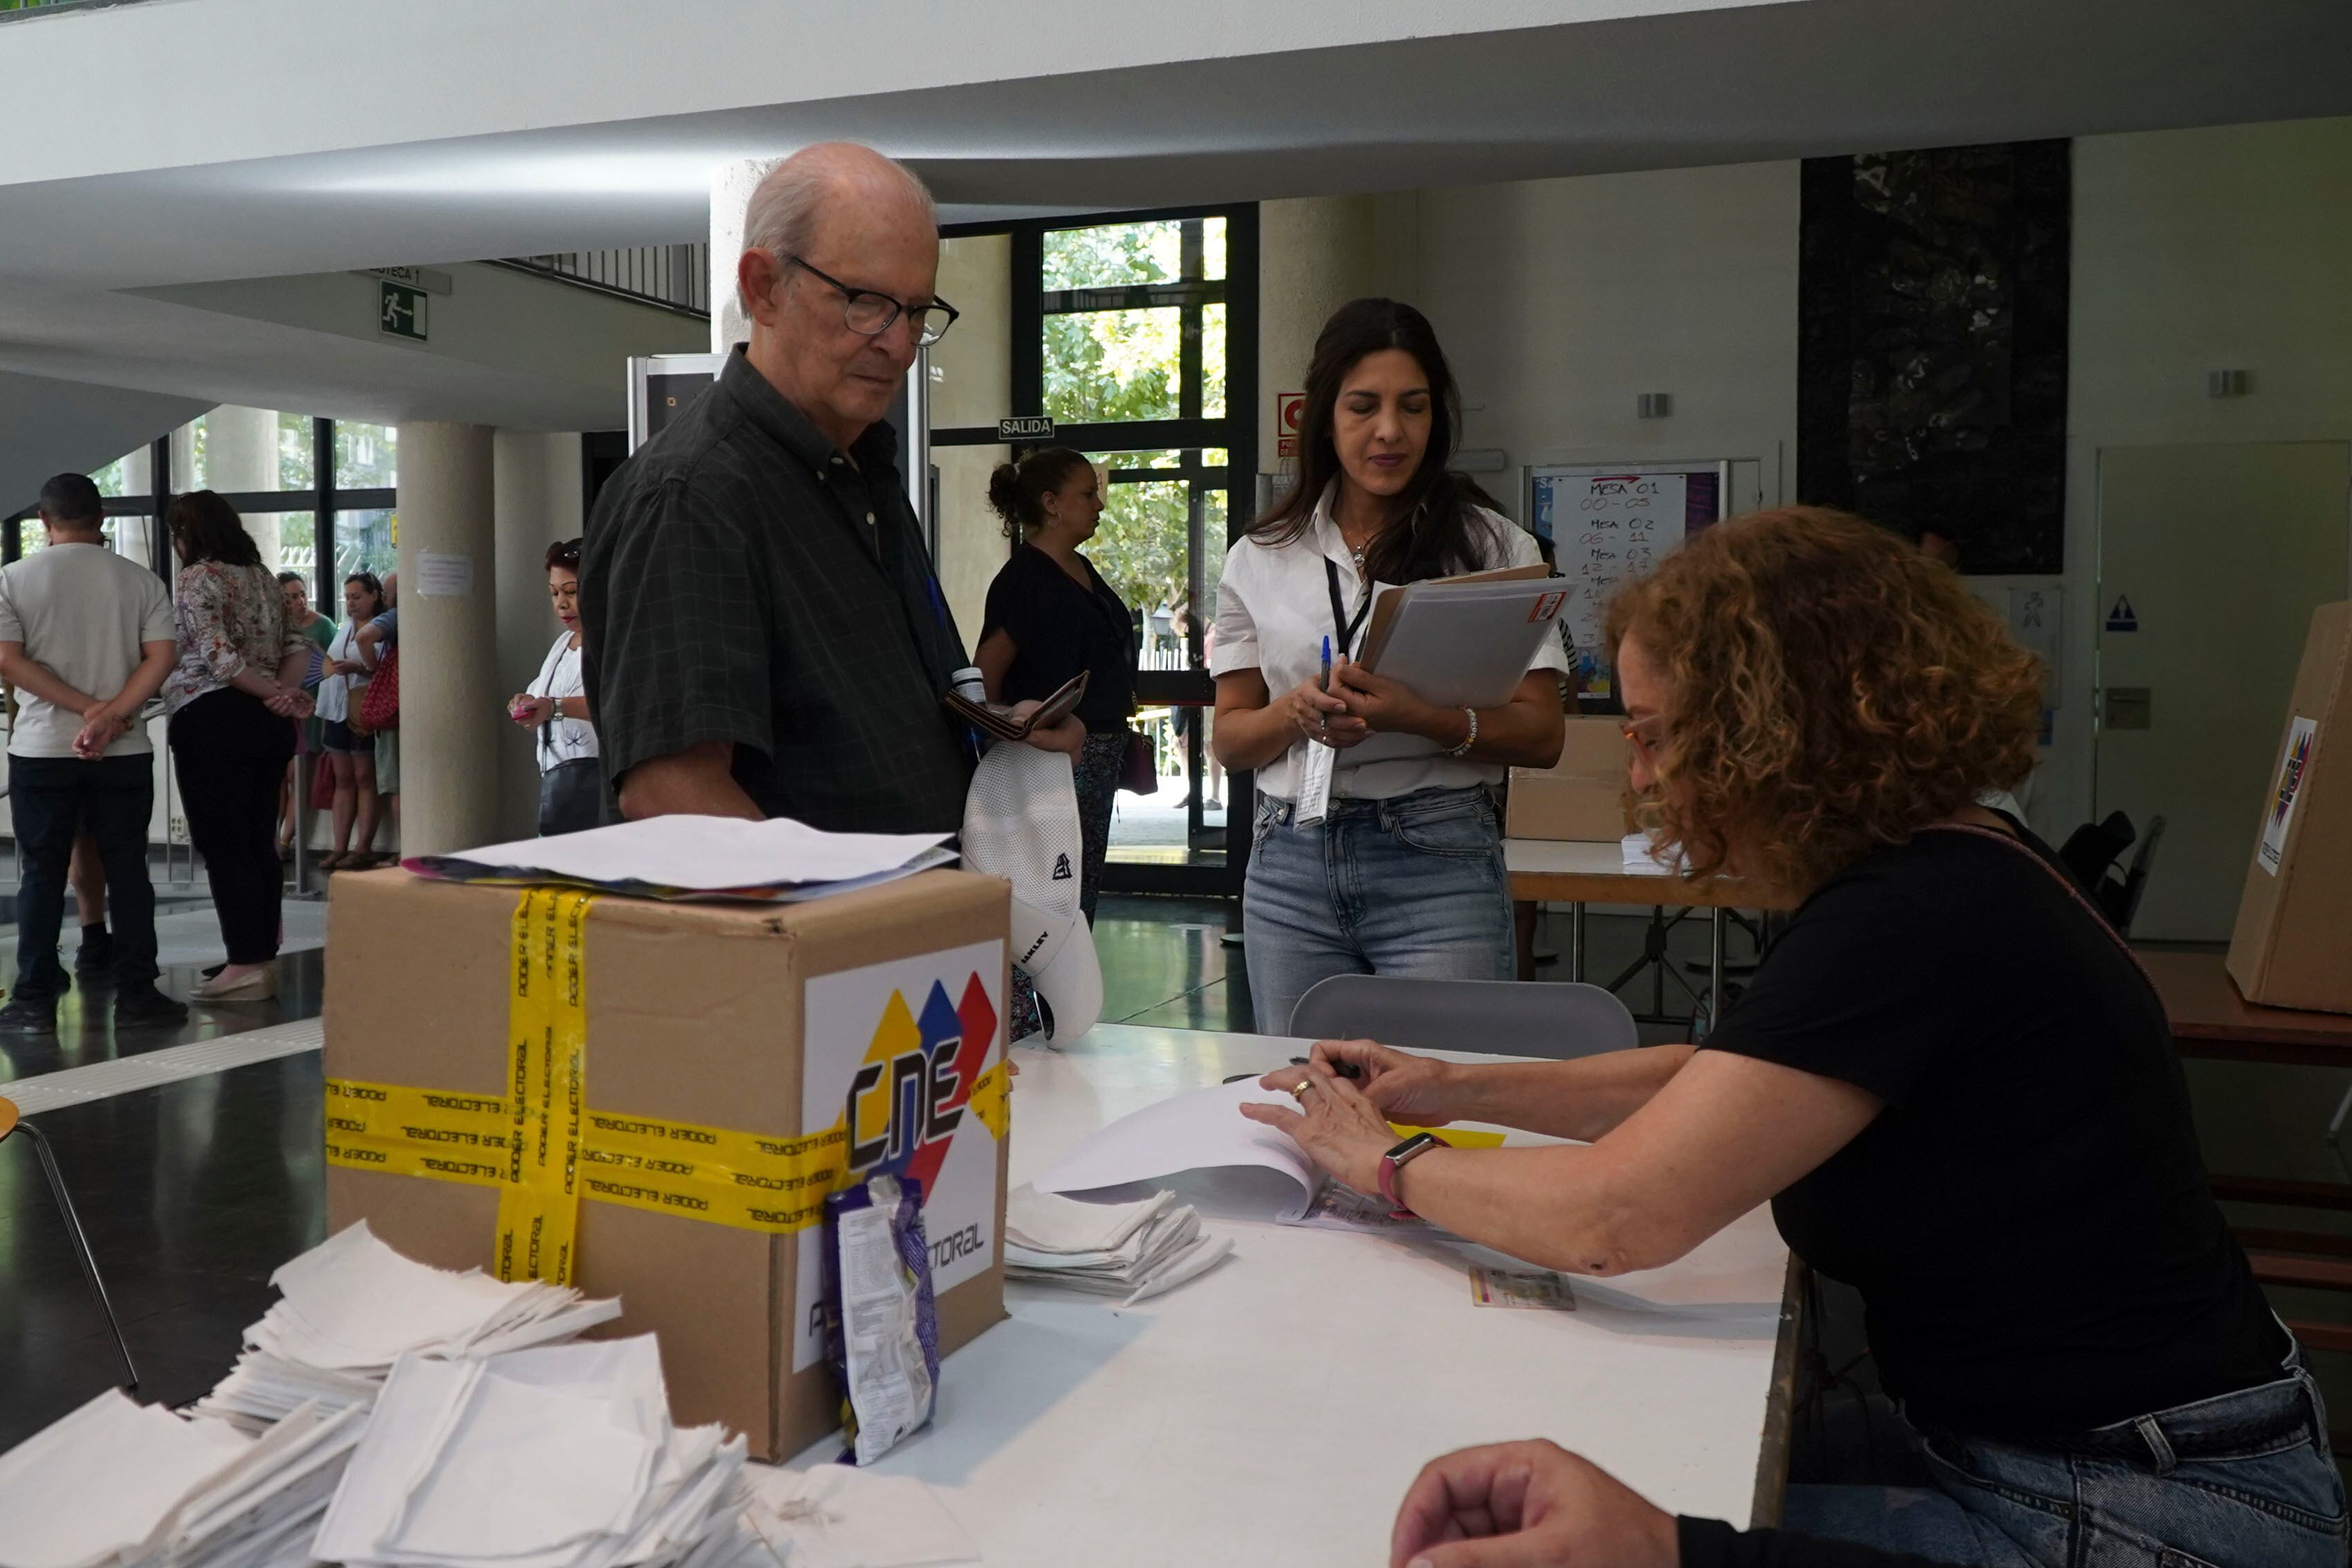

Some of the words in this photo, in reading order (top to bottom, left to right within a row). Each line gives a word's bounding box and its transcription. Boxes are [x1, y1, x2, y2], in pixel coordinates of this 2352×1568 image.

[1002, 420, 1051, 433] SALIDA
[1590, 483, 1628, 496] MESA
[1636, 483, 1660, 494] 01
[1580, 498, 1607, 510] 00
[1625, 498, 1650, 509] 05
[1590, 519, 1619, 530] MESA
[1628, 517, 1655, 530] 02
[670, 1128, 717, 1145] PODER
[645, 1158, 694, 1175] PODER
[663, 1192, 709, 1211] PODER
